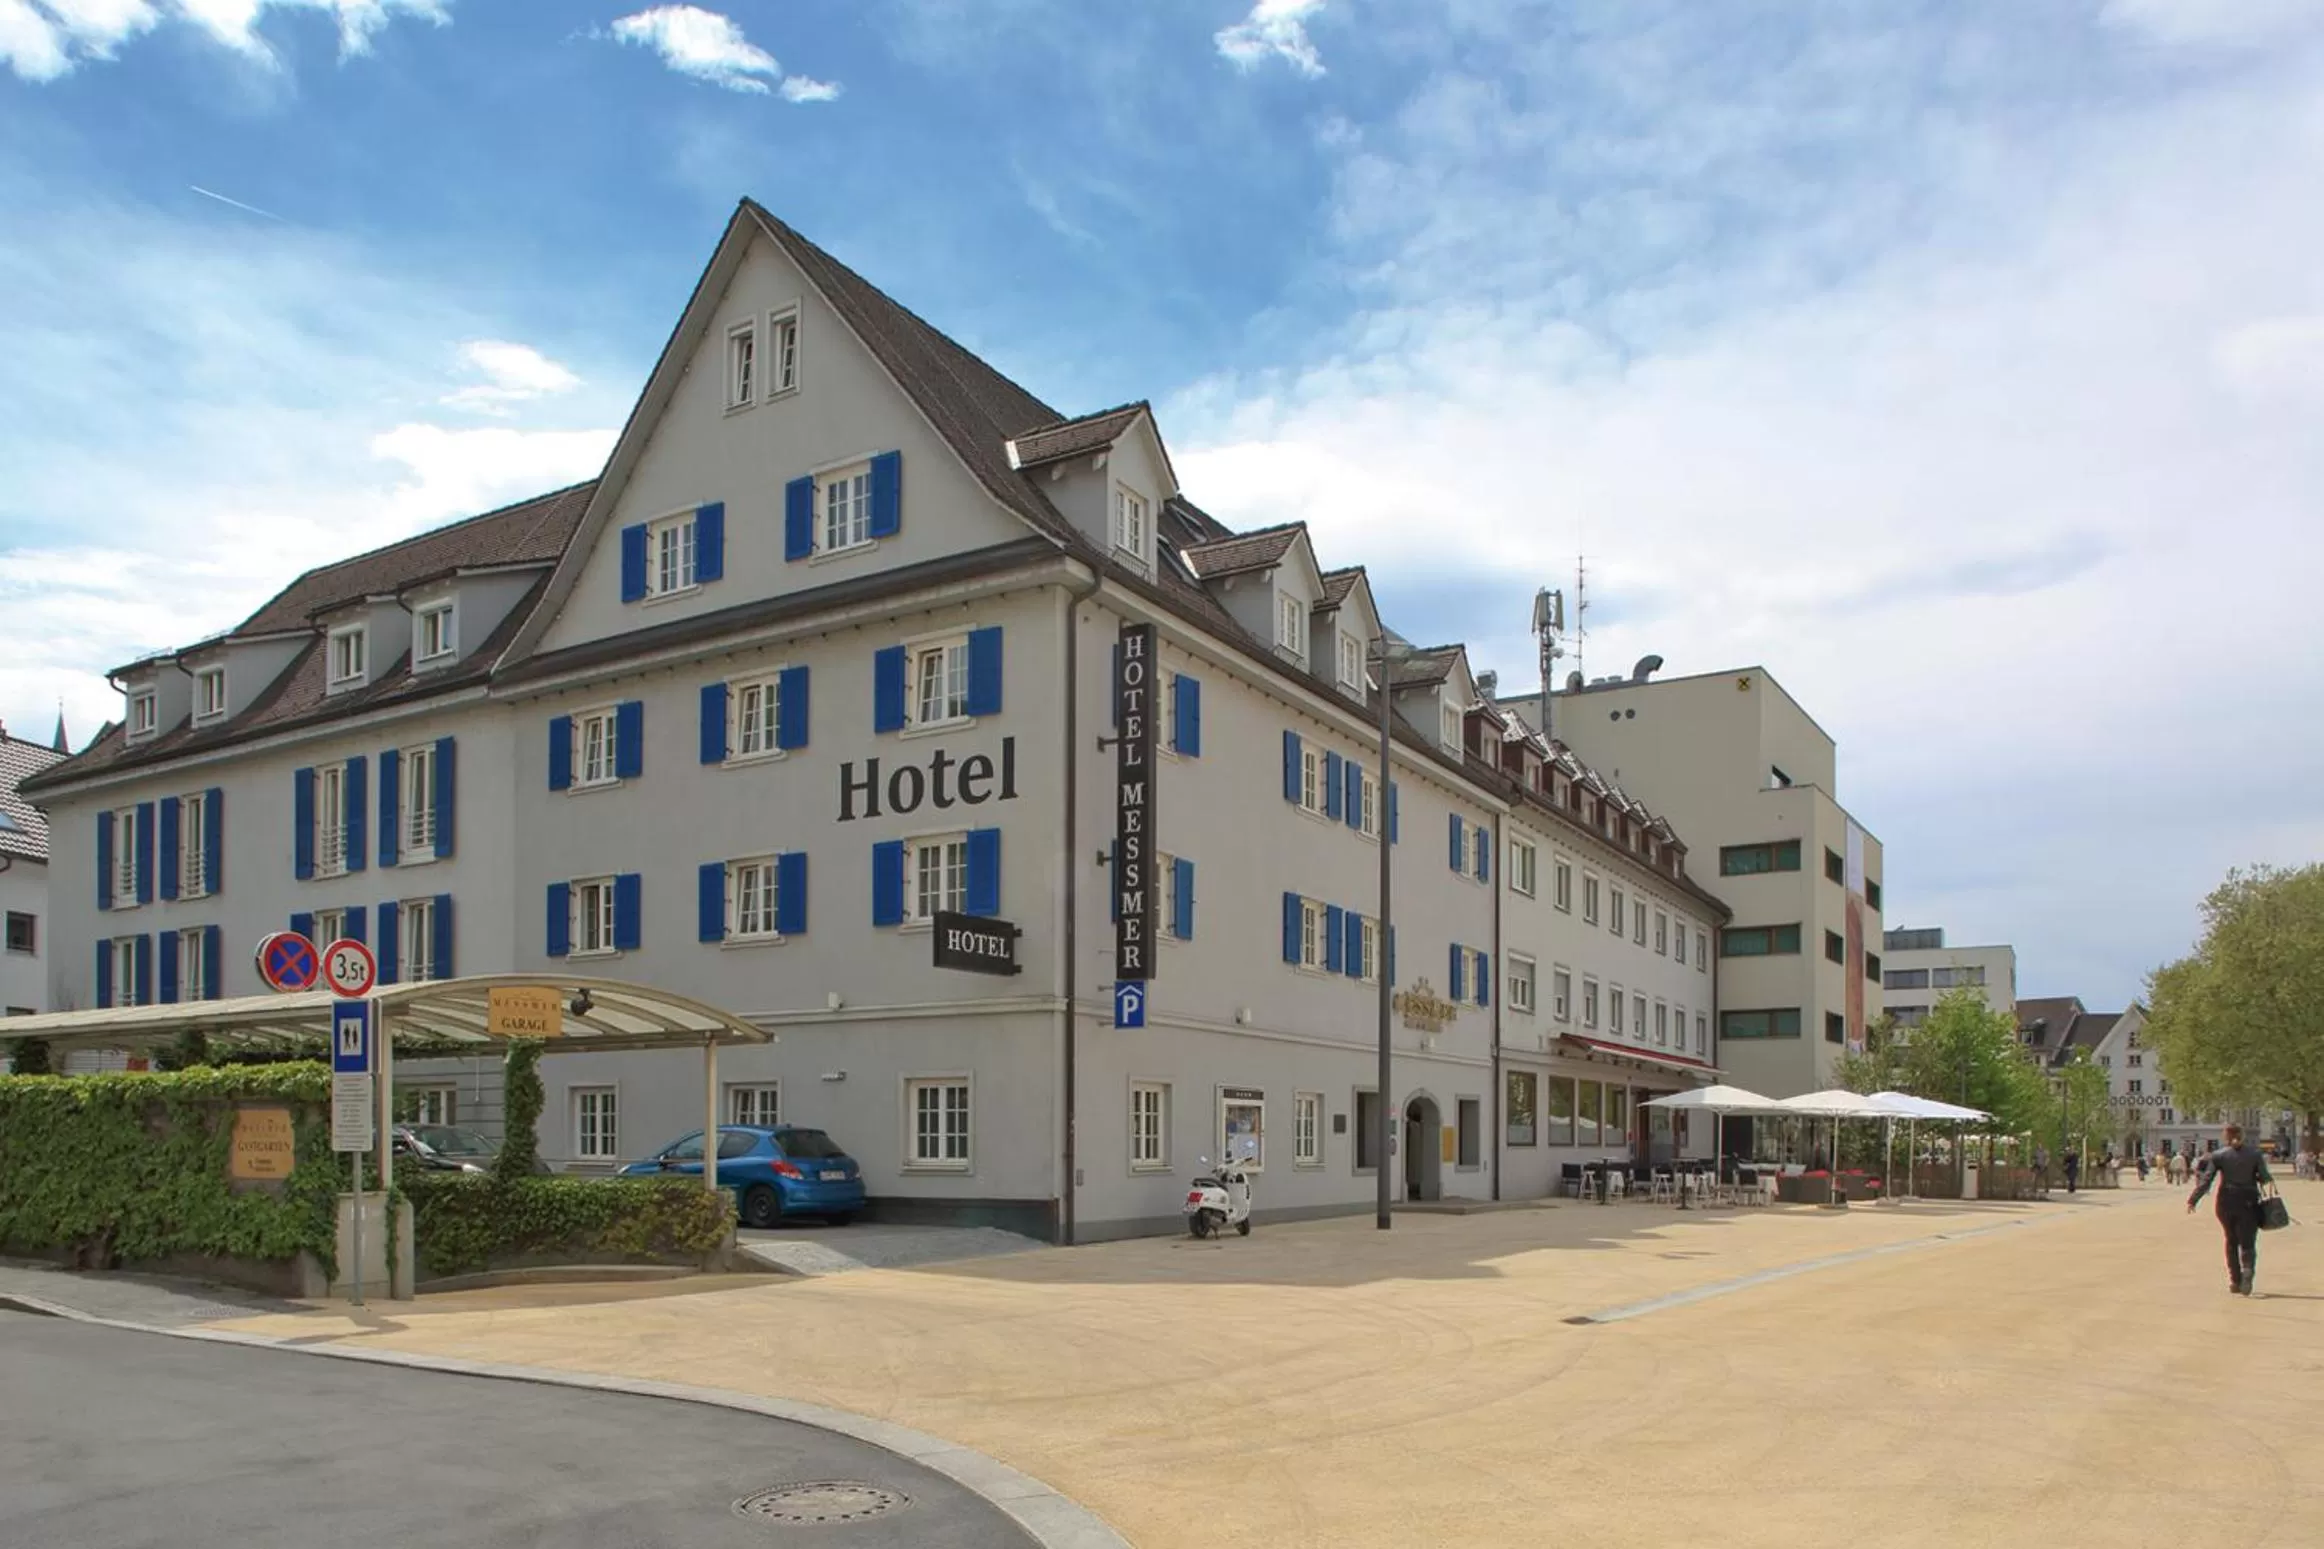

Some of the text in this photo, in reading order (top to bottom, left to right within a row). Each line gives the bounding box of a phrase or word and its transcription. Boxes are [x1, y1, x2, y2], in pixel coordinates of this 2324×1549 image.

[836, 736, 1019, 823] Hotel
[1121, 634, 1145, 969] HOTEL MESSMER
[947, 928, 1010, 959] HOTEL
[500, 1016, 547, 1033] GARAGE
[1122, 994, 1140, 1024] P
